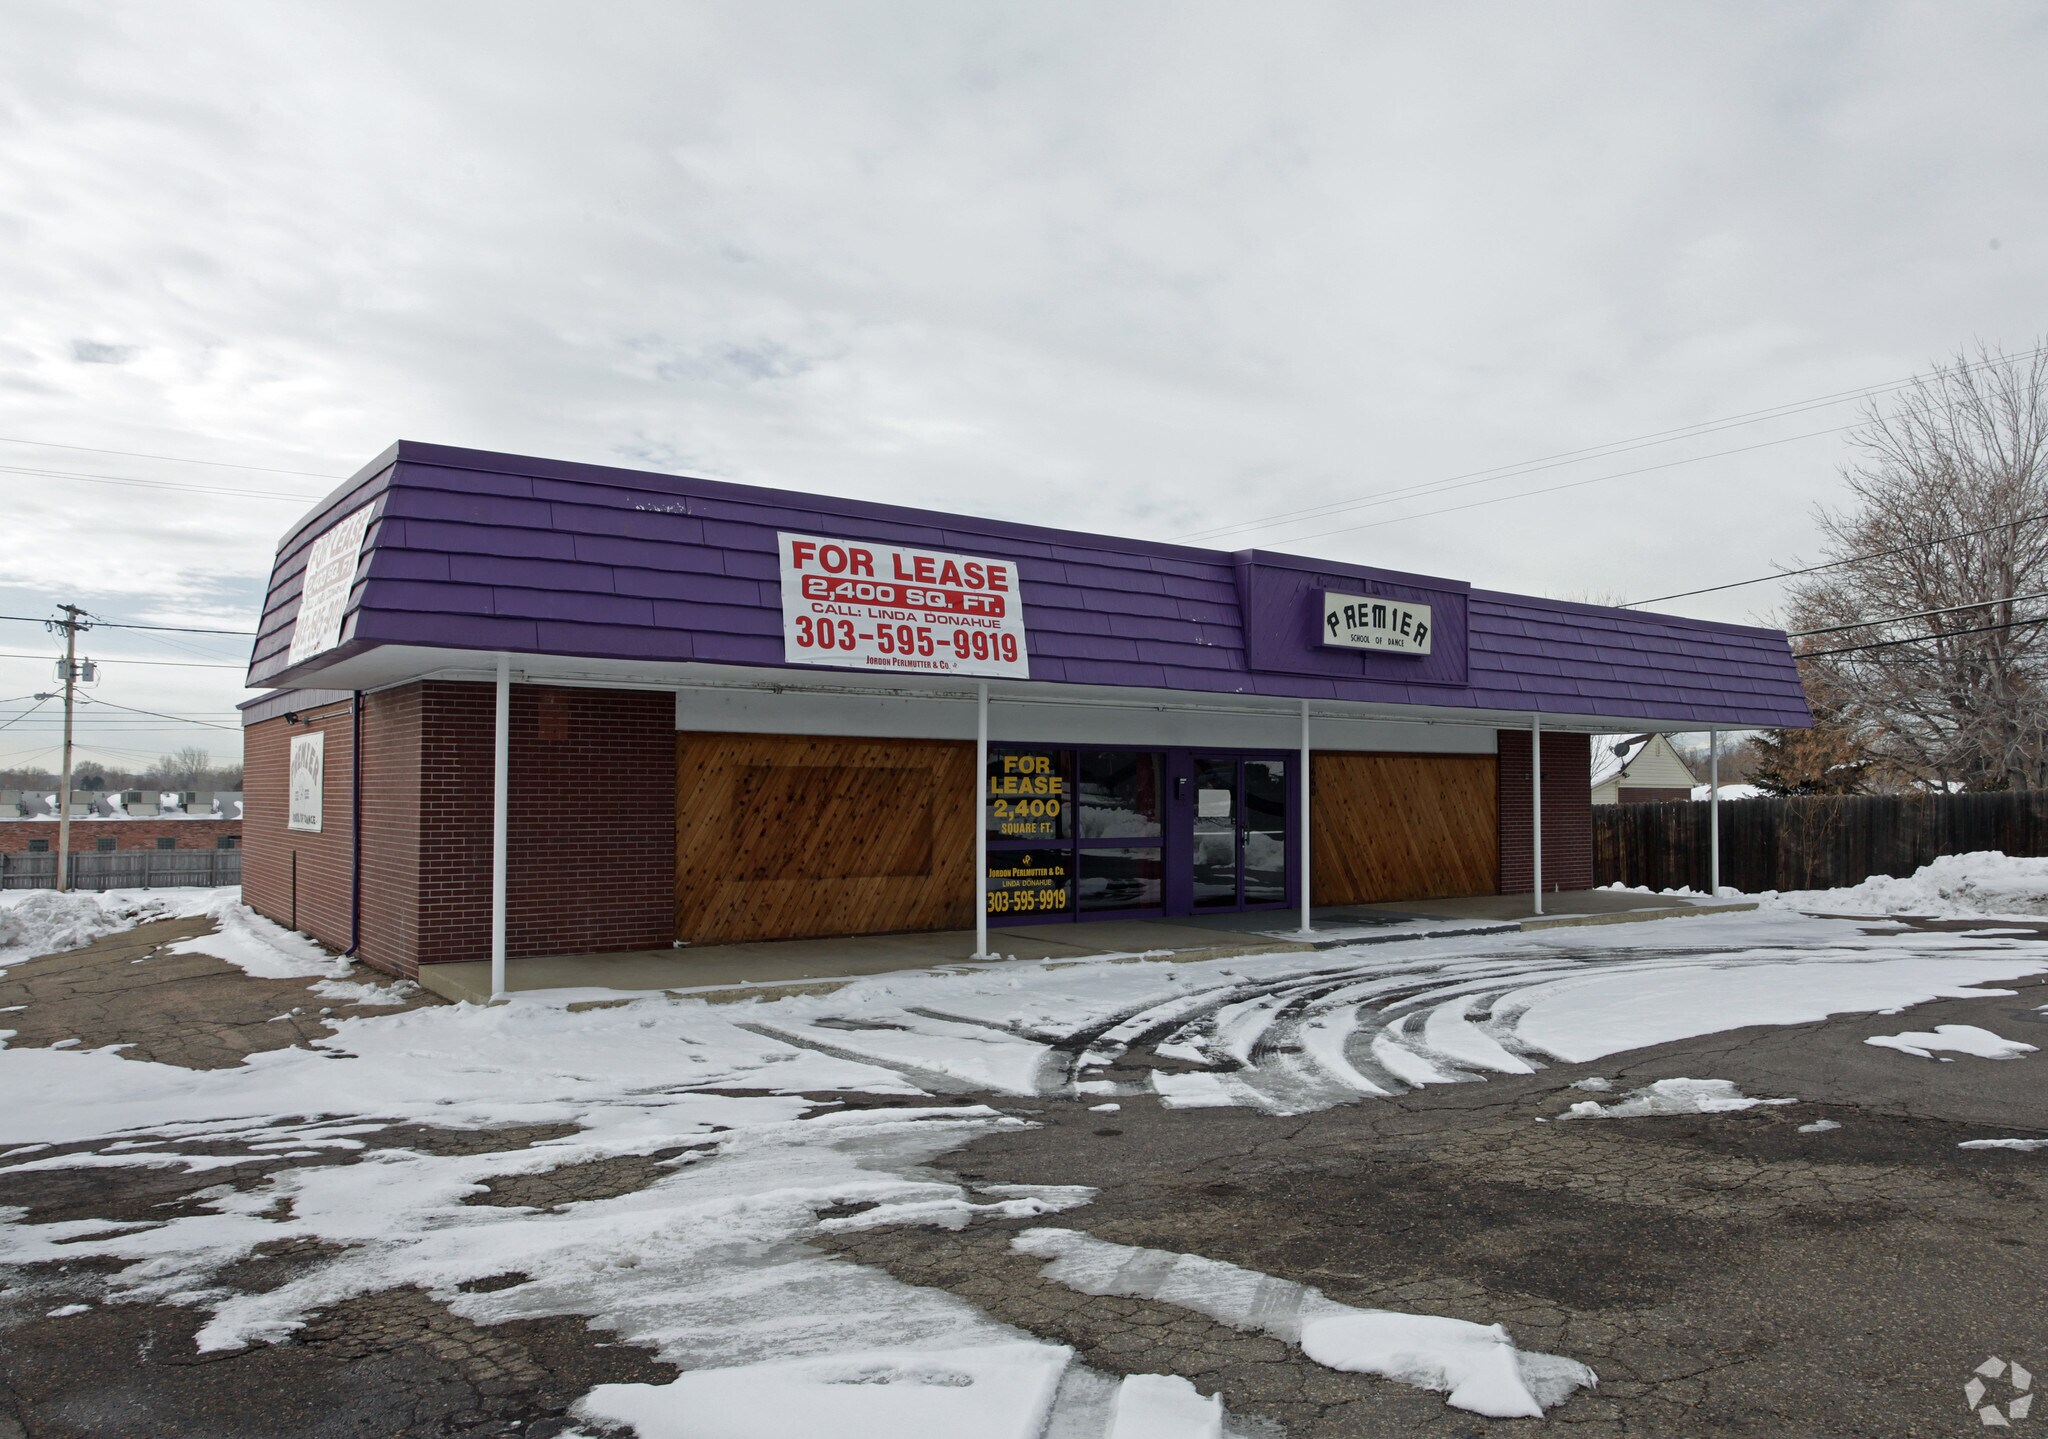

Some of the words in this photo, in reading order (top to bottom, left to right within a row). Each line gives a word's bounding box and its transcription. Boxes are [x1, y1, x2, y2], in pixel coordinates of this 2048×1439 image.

[332, 513, 369, 558] LEASE
[792, 540, 875, 577] FOR
[892, 553, 1009, 592] LEASE
[808, 578, 895, 603] 2,400
[906, 589, 953, 609] SQ.
[963, 594, 1001, 613] FT.
[811, 602, 861, 617] CALL:
[868, 607, 918, 622] LINDA
[924, 613, 1002, 629] DONAHUE
[1327, 603, 1428, 647] PREMIER
[795, 615, 1018, 663] 303-595-9919
[1350, 634, 1370, 644] SCHOOL
[1375, 637, 1383, 645] OF
[1388, 638, 1404, 647] DANCE
[892, 657, 932, 669] PERLMUTTER
[933, 661, 938, 669] &
[1004, 756, 1050, 774] FOR
[991, 776, 1062, 794] LEASE
[994, 799, 1060, 821] 2,400
[1002, 822, 1036, 835] SQUARE
[1040, 822, 1053, 833] FT.
[1012, 867, 1047, 878] PERLMUTTER
[1048, 868, 1054, 876] &
[1022, 878, 1052, 886] DONAHUE
[988, 888, 1066, 912] 303-595-9919
